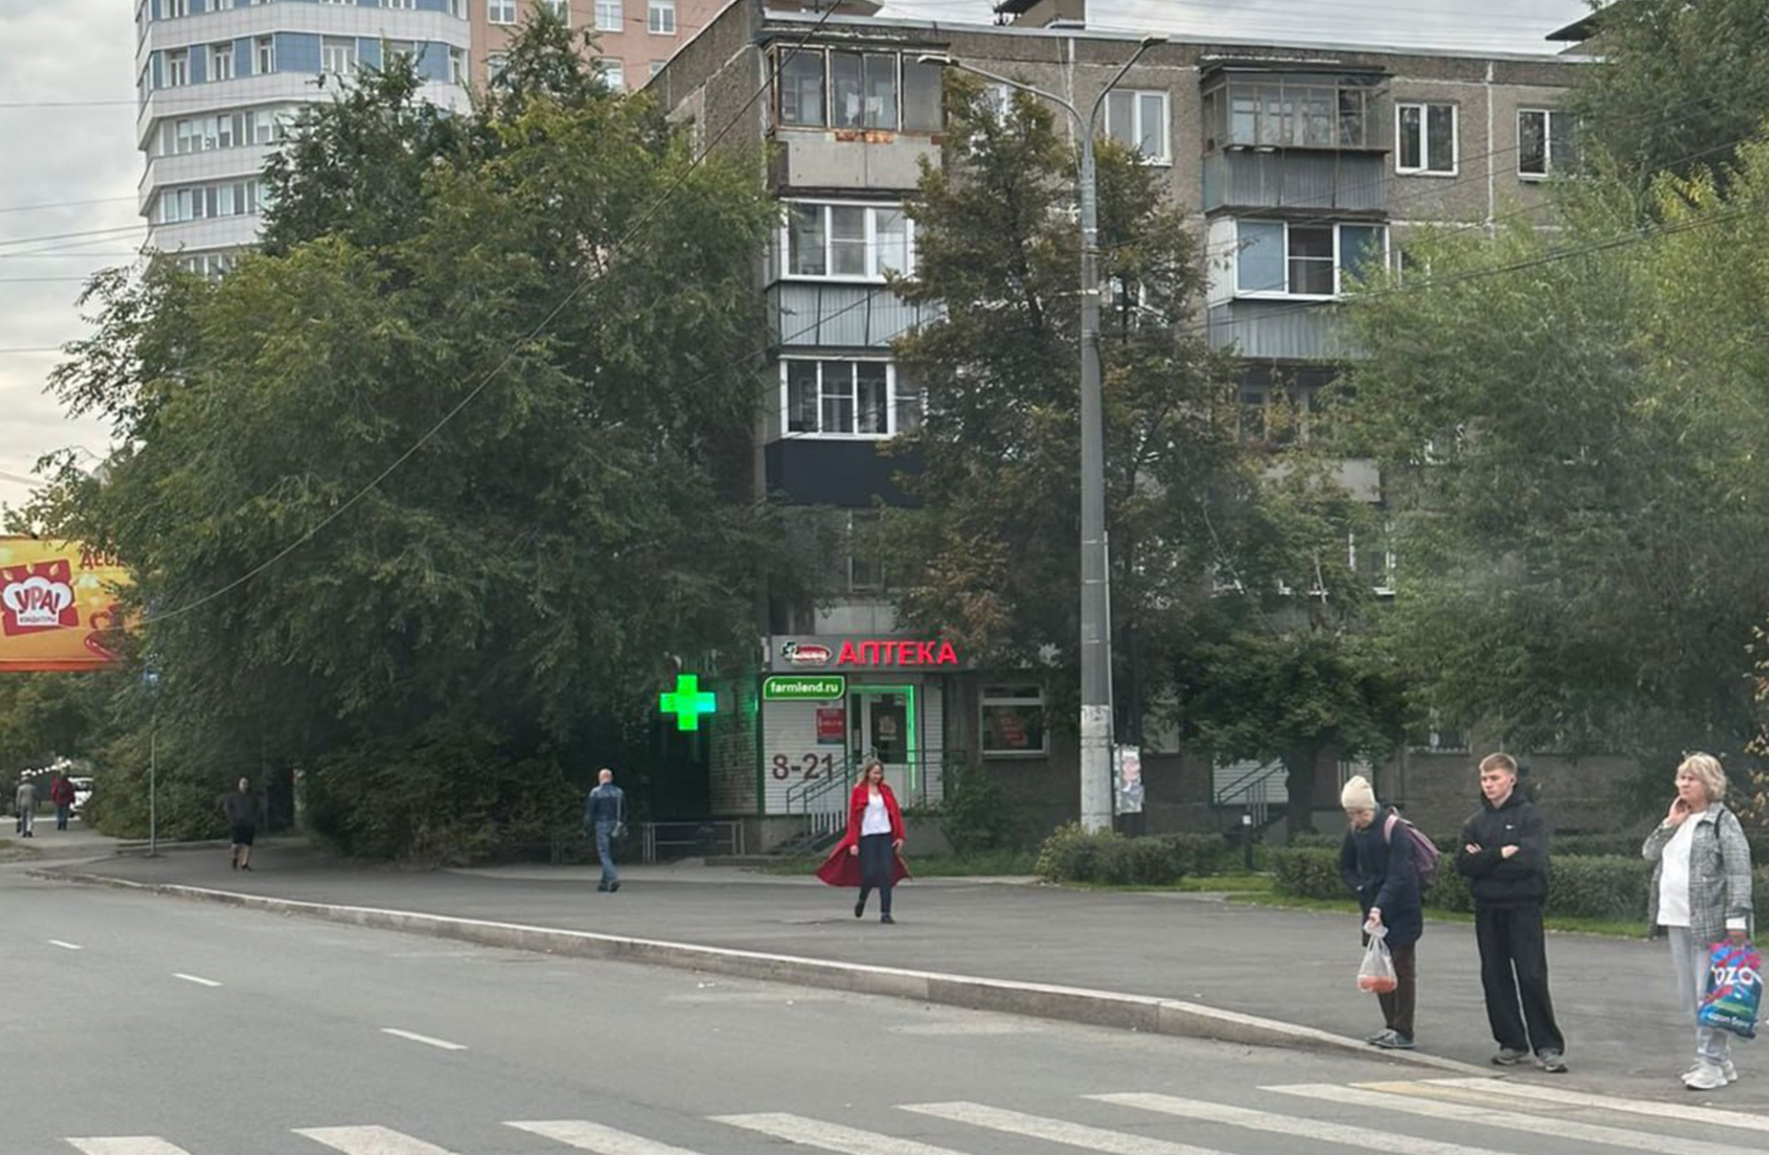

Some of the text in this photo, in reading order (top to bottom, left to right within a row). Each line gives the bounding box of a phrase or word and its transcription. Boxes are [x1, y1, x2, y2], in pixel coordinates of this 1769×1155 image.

[14, 586, 61, 614] УРА!
[838, 640, 958, 665] АПТЕКА
[772, 753, 834, 780] 8-21
